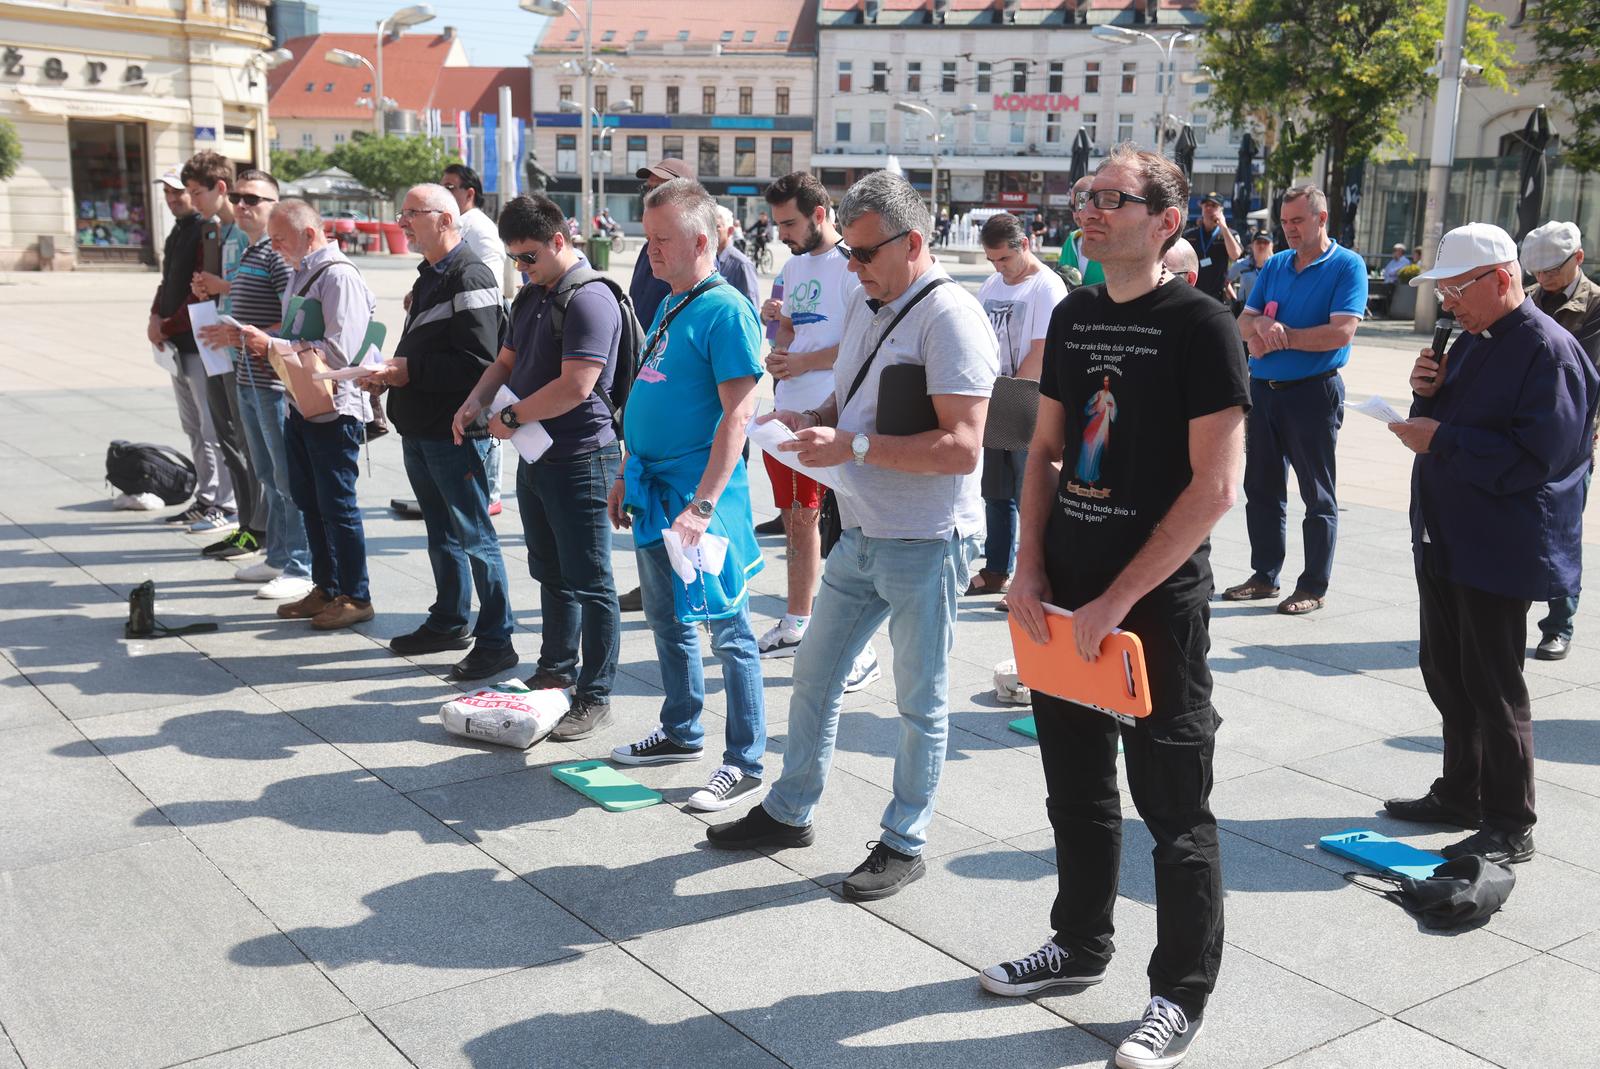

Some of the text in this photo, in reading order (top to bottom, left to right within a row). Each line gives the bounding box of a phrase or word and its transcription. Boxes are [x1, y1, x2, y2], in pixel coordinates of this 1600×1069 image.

[992, 94, 1080, 112] KONZUM
[1072, 323, 1162, 336] Bog je beskonačno milosrdan
[1090, 352, 1102, 361] Oca
[1125, 344, 1135, 353] od
[1134, 345, 1158, 356] gnjeva
[1081, 500, 1092, 511] tko
[1092, 503, 1113, 514] bude
[1130, 508, 1137, 516] u
